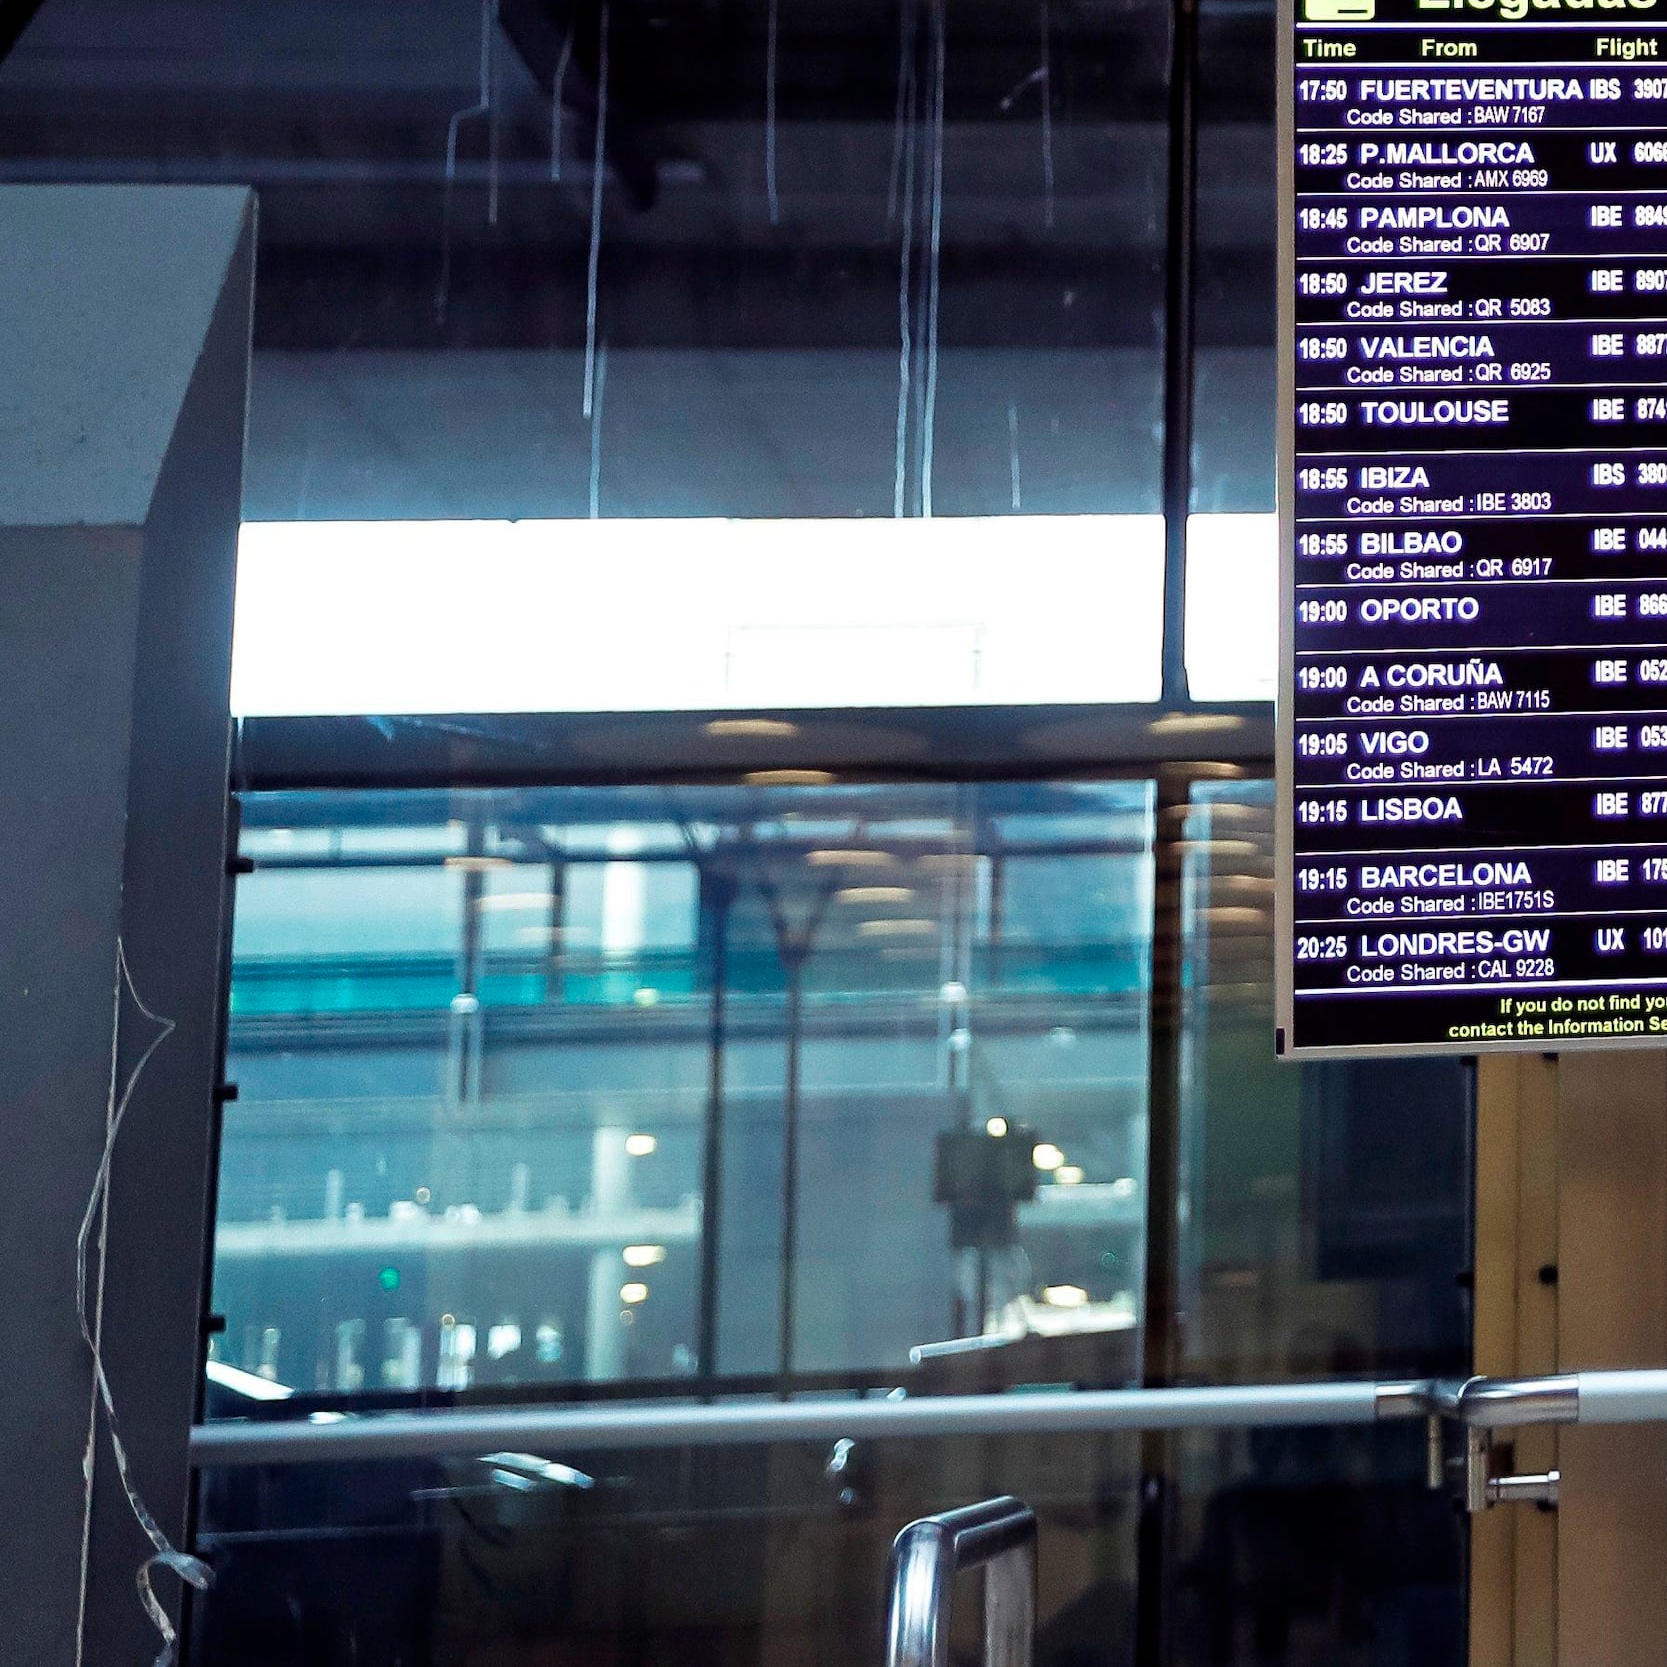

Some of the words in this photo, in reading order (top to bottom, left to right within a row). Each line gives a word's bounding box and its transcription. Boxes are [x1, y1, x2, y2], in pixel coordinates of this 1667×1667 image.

[1300, 80, 1347, 100] 17:50
[1361, 79, 1584, 100] FUERTEVENTURA
[1590, 78, 1621, 100] IBS
[1299, 800, 1347, 822] 19:15
[1362, 797, 1462, 821] LISBOA
[1597, 793, 1628, 815] IBE
[1501, 998, 1512, 1013] If
[1516, 1001, 1546, 1016] you
[1551, 997, 1573, 1012] do
[1578, 996, 1605, 1011] not
[1609, 994, 1640, 1010] find
[1449, 1022, 1513, 1037] contact
[1517, 1020, 1544, 1035] the
[1549, 1017, 1644, 1034] Information
